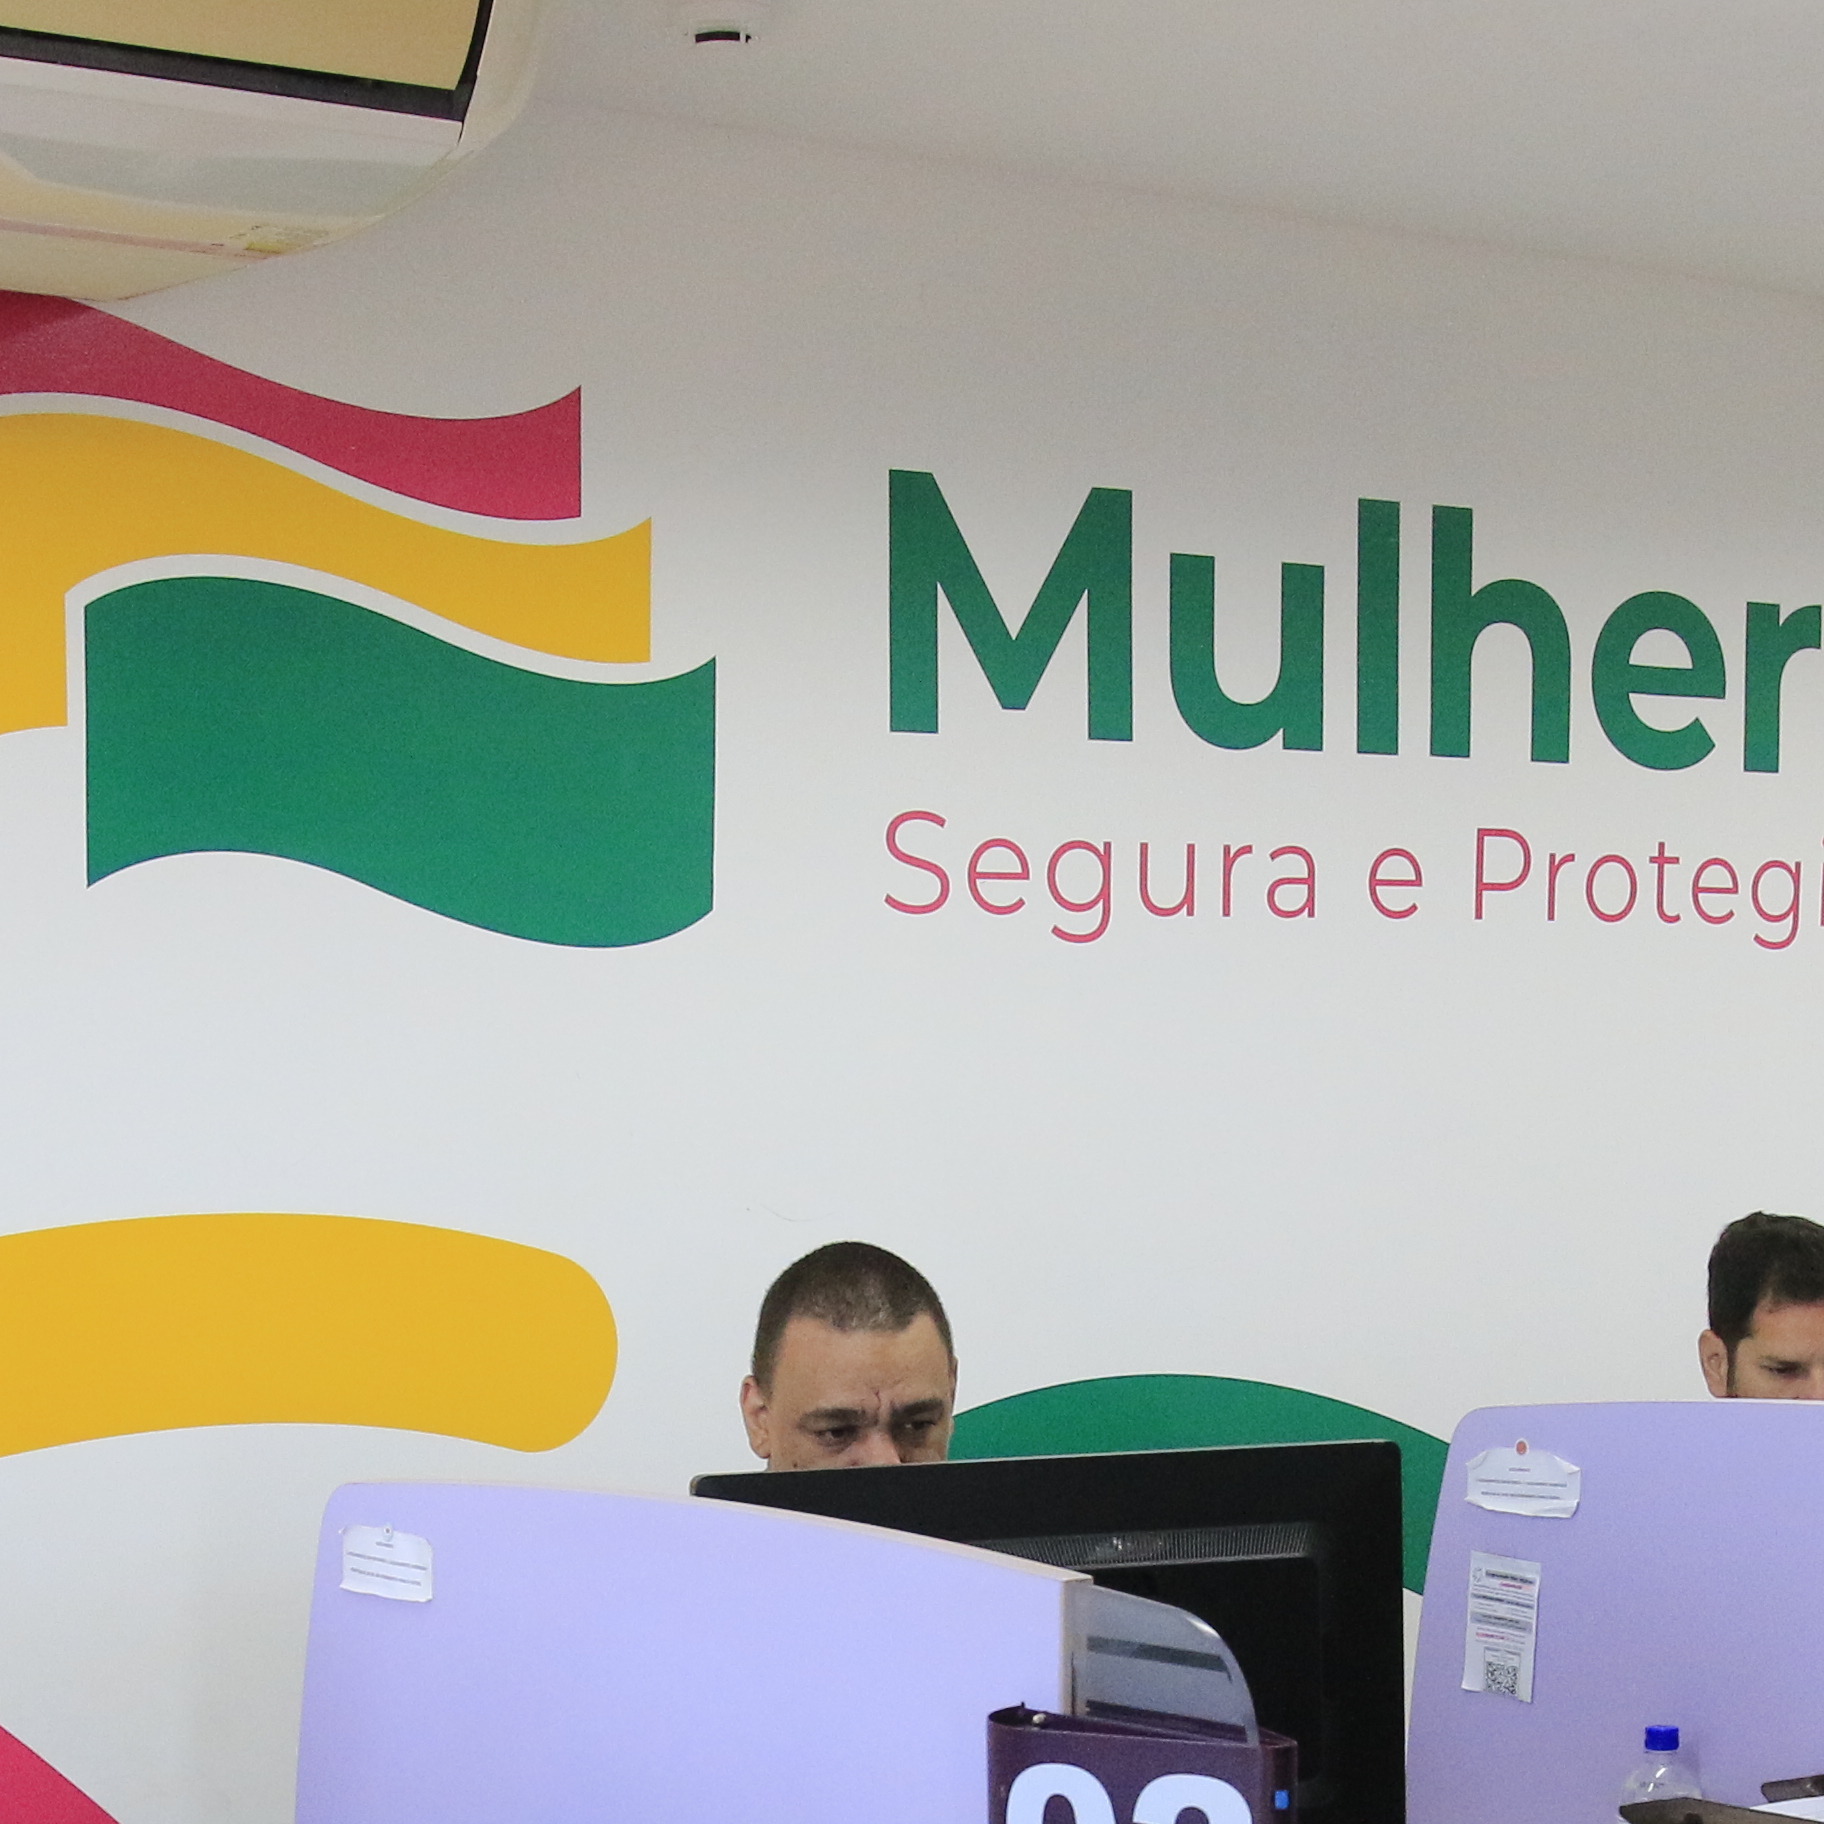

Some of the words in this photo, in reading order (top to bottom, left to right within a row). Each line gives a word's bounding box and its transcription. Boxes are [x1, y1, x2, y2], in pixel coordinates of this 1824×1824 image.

[889, 469, 1822, 773] Mulher
[884, 810, 1316, 943] Segura
[1368, 847, 1424, 920] e
